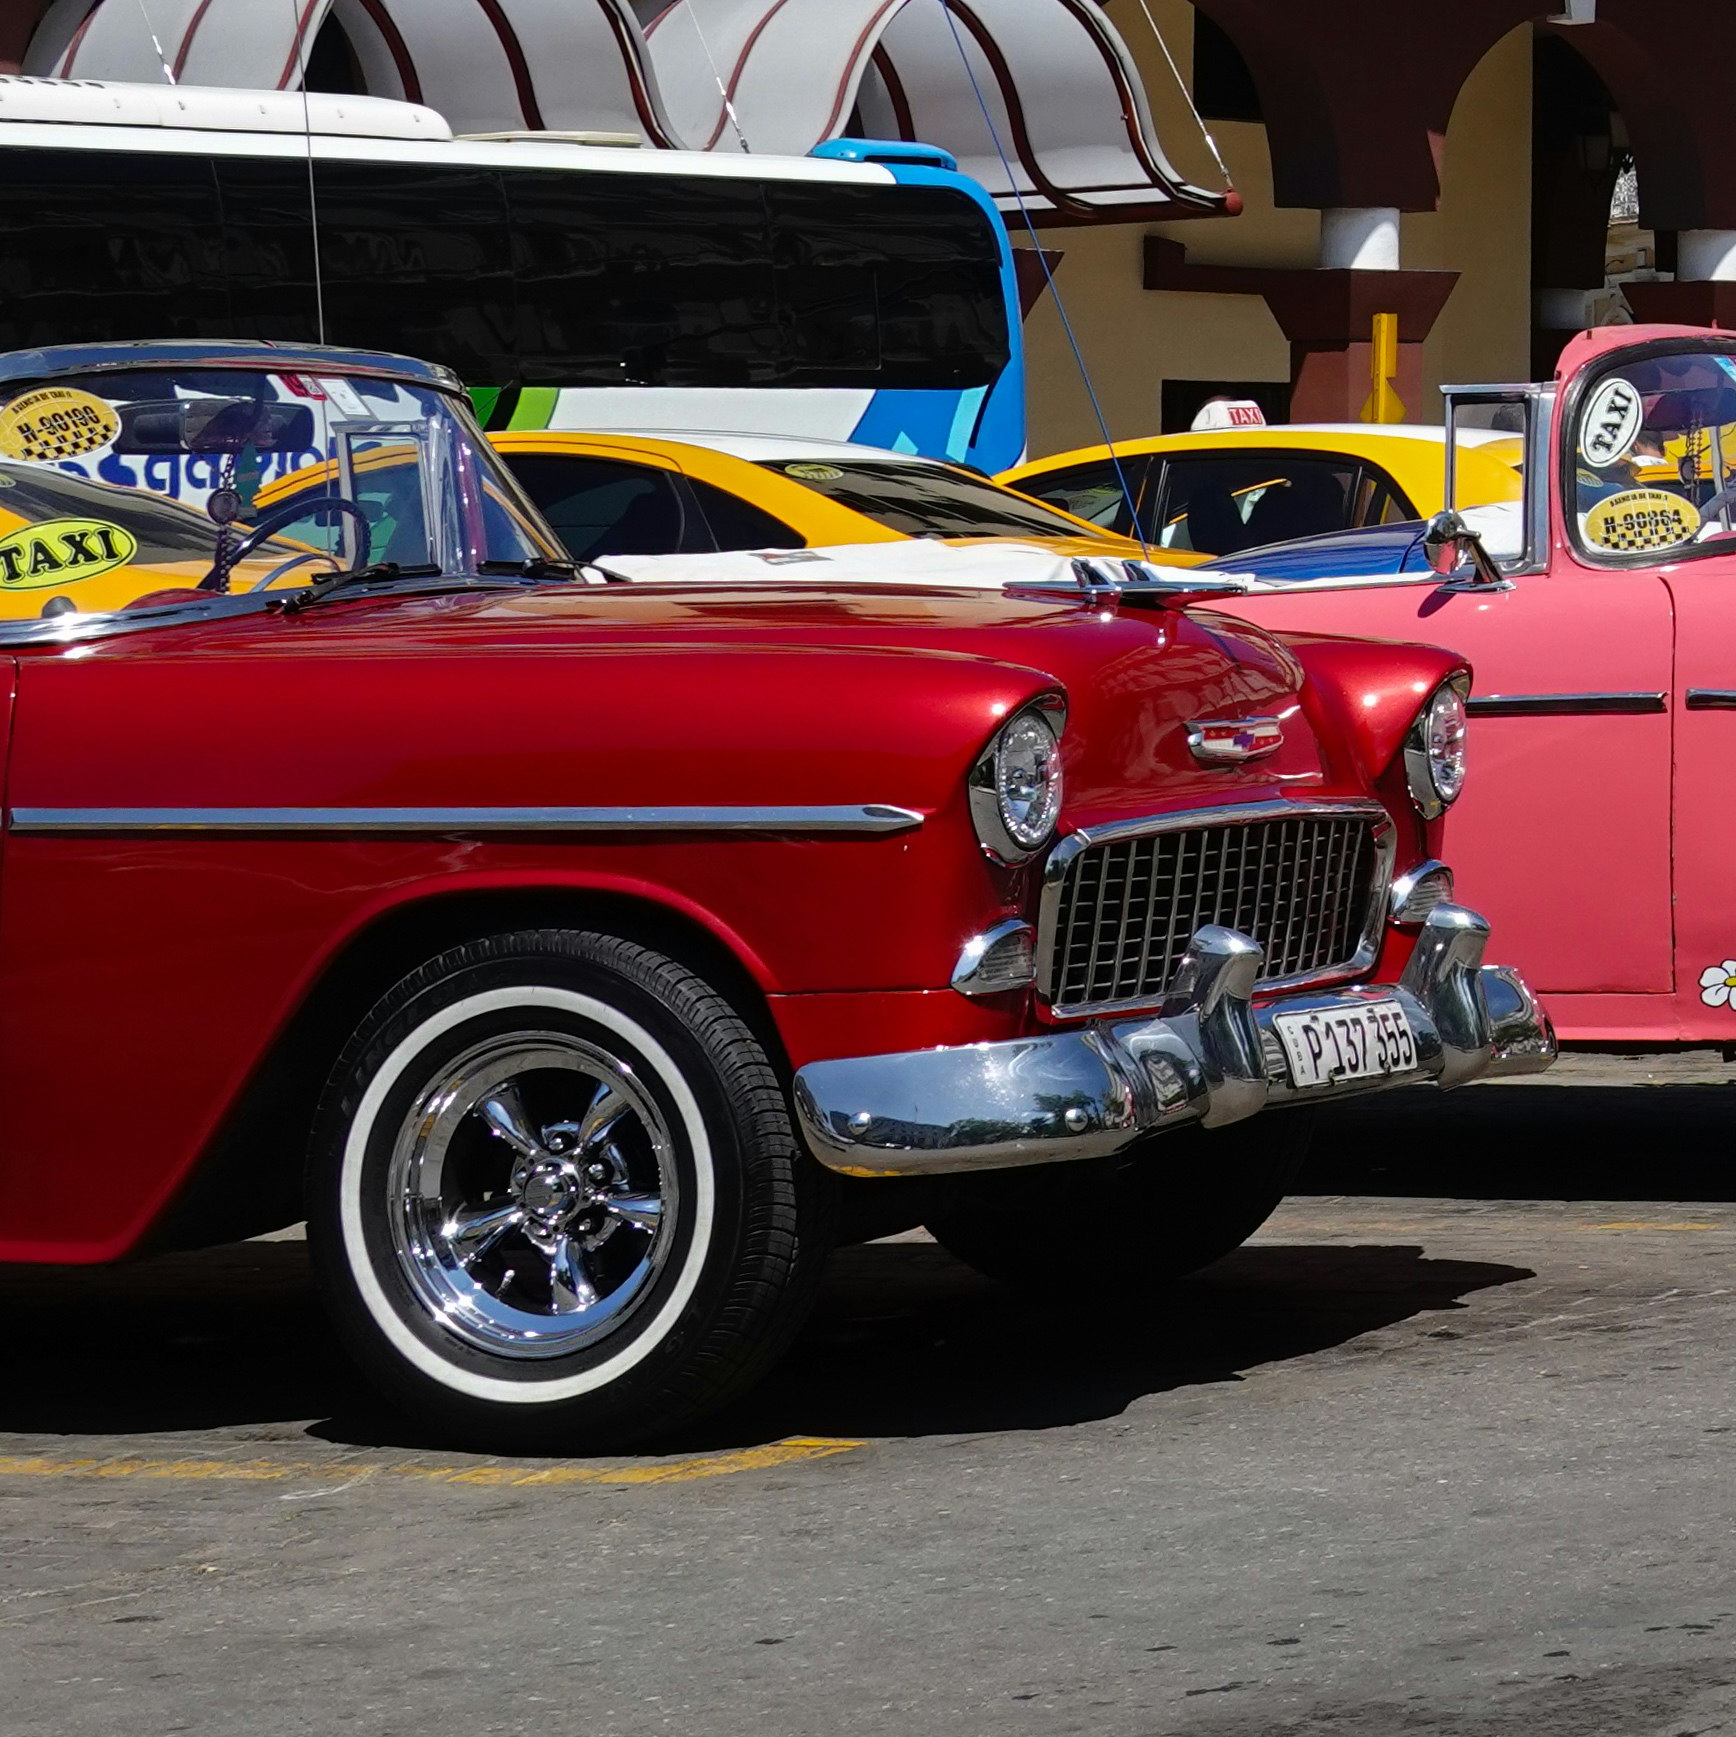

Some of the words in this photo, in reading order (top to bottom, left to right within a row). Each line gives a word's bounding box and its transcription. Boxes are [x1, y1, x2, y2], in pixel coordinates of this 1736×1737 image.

[16, 405, 101, 444] H-90190
[1228, 408, 1262, 424] TAXI
[1591, 387, 1632, 453] TAXI
[1603, 509, 1683, 535] H-90864
[0, 529, 120, 581] TAXI
